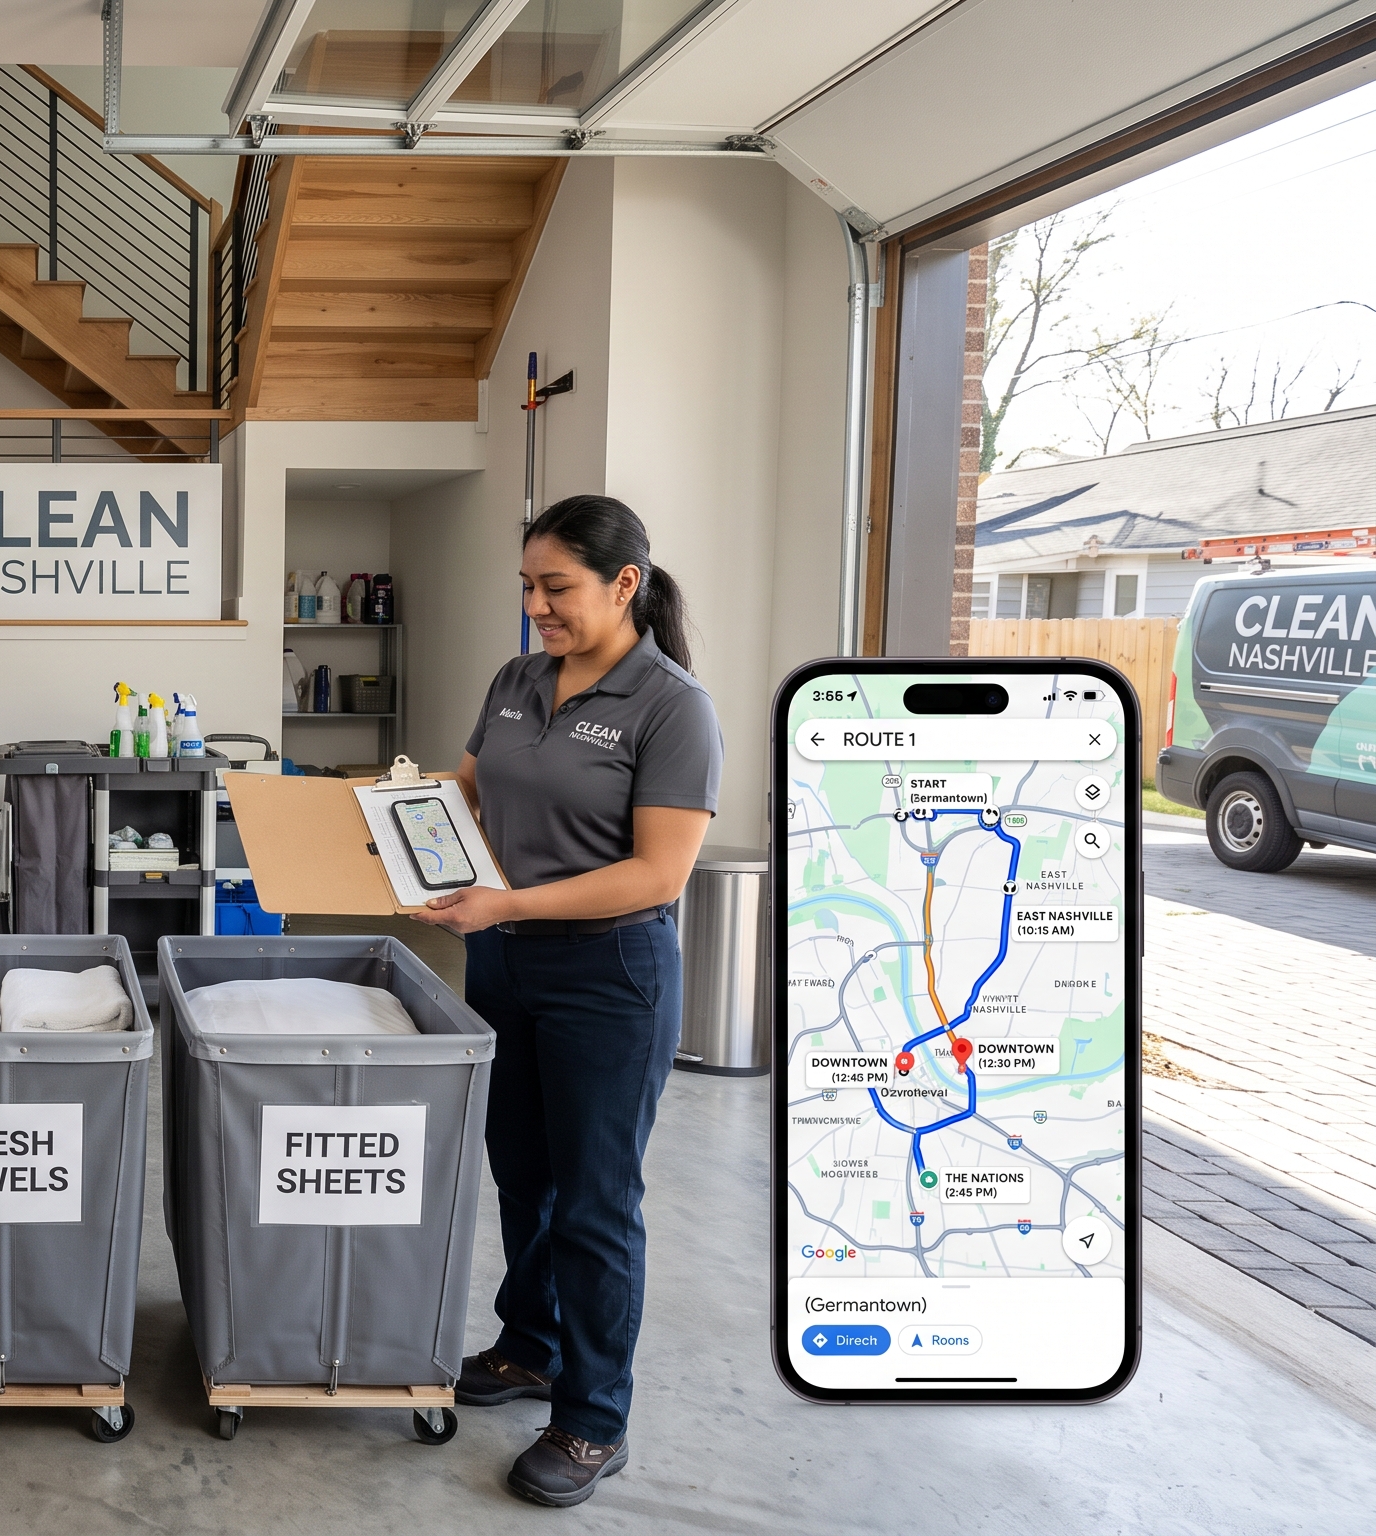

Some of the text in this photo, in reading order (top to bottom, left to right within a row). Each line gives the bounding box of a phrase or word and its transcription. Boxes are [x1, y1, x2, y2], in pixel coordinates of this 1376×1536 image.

[1228, 642, 1376, 677] NASHVILLE
[575, 721, 622, 743] CLEAN
[843, 732, 916, 747] ROUTE 1
[910, 779, 947, 789] START
[1041, 870, 1067, 879] EAST
[1026, 882, 1084, 890] NASHVILLE
[1017, 911, 1113, 921] EAST NASHVILLE
[1052, 925, 1074, 935] AM)
[972, 1005, 1027, 1014] NASHVILLE
[978, 1044, 1055, 1054] DOWNTOWN
[811, 1057, 889, 1068] DOWNTOWN
[978, 1058, 1036, 1069] (12:30 PM)
[867, 1073, 889, 1083] PM)
[286, 1133, 399, 1158] FITTED
[277, 1168, 406, 1194] SHEETS
[945, 1173, 1024, 1183] THE NATIONS
[945, 1187, 998, 1199] (2:45 PM)
[801, 1245, 857, 1262] Google
[805, 1296, 927, 1314] (Germantown)
[932, 1335, 970, 1346] Roons
